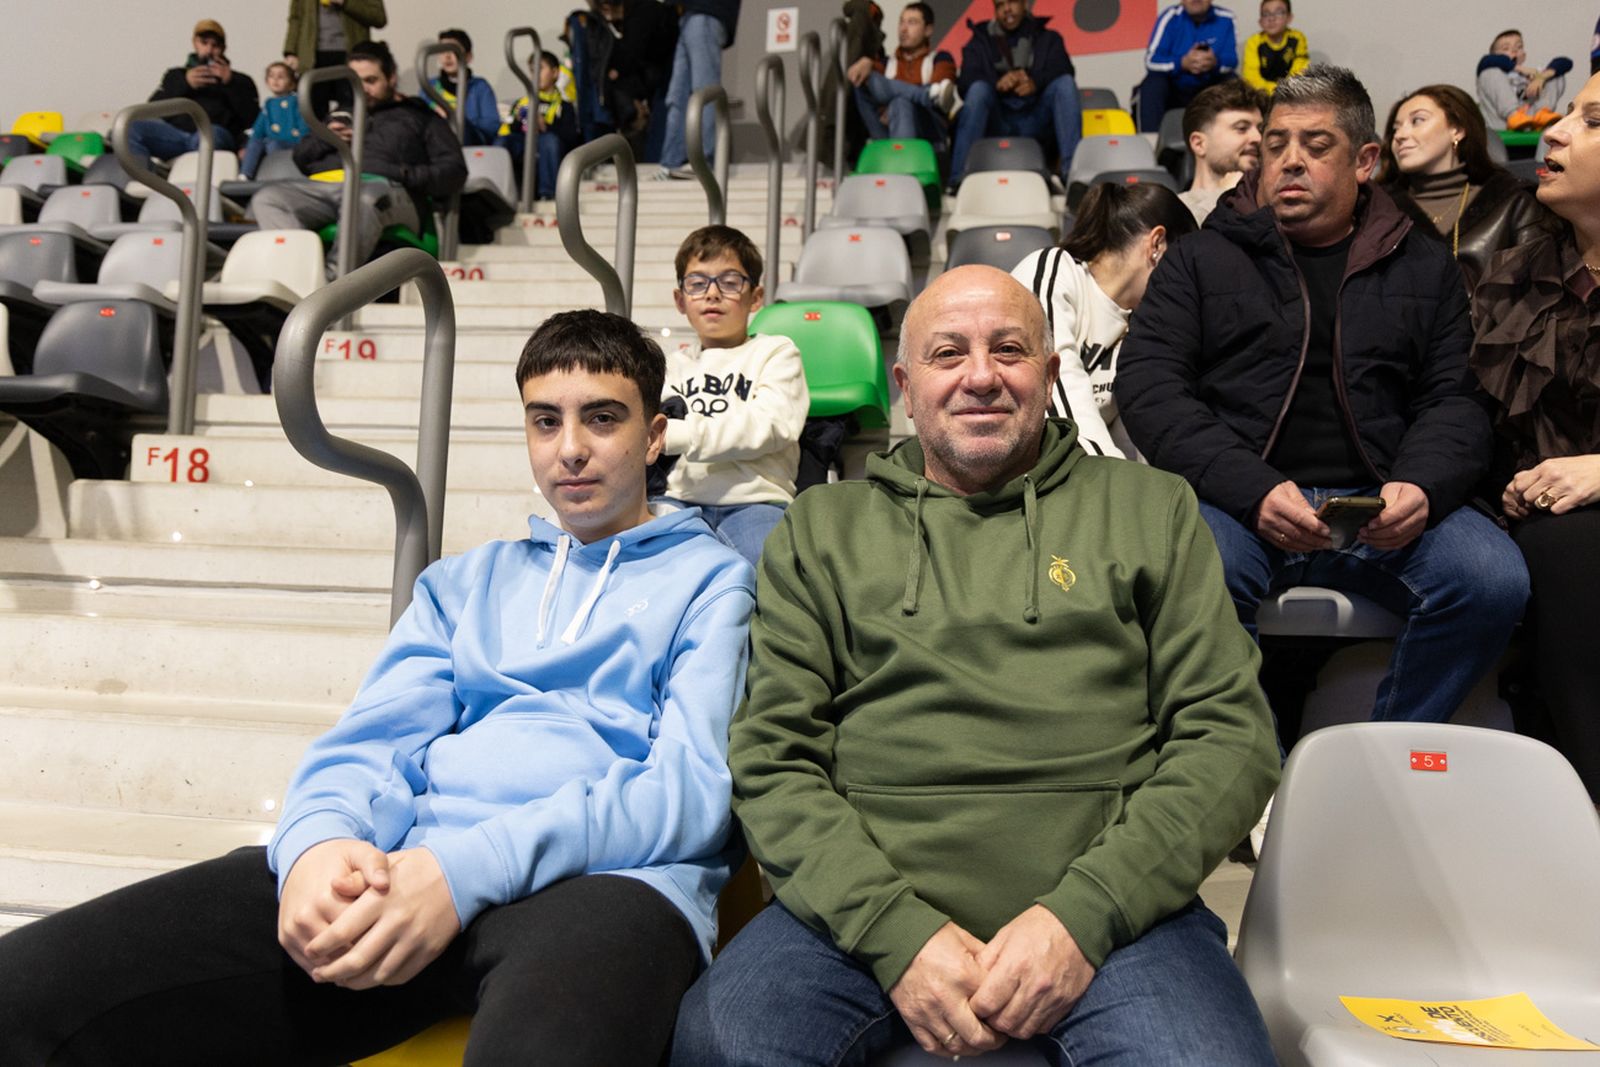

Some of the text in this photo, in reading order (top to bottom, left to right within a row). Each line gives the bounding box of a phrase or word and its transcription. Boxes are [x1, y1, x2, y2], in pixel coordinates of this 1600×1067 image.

[324, 339, 377, 360] F19
[147, 447, 209, 483] F18
[1424, 754, 1434, 768] 5
